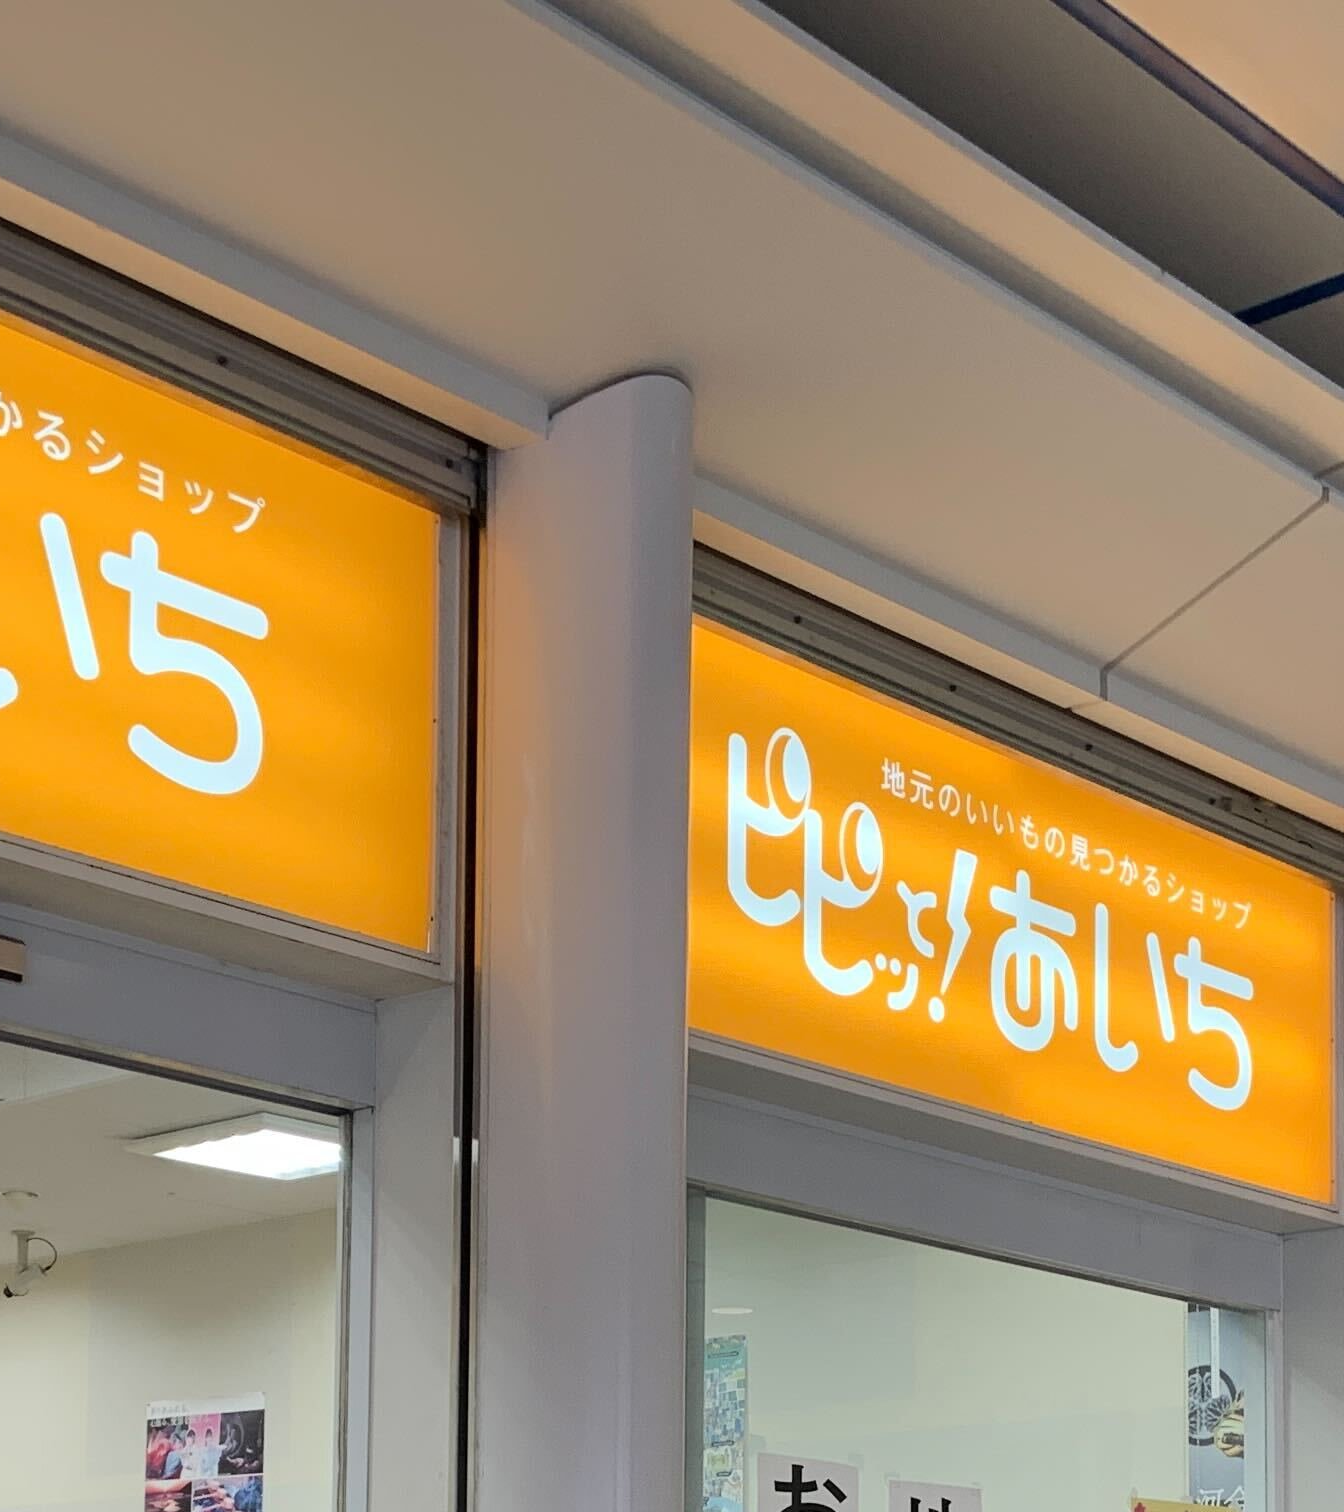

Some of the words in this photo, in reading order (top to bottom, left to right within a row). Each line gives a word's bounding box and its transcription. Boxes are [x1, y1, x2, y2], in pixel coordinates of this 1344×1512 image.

[880, 756, 1253, 930] 地元のいいもの見つかるショップ
